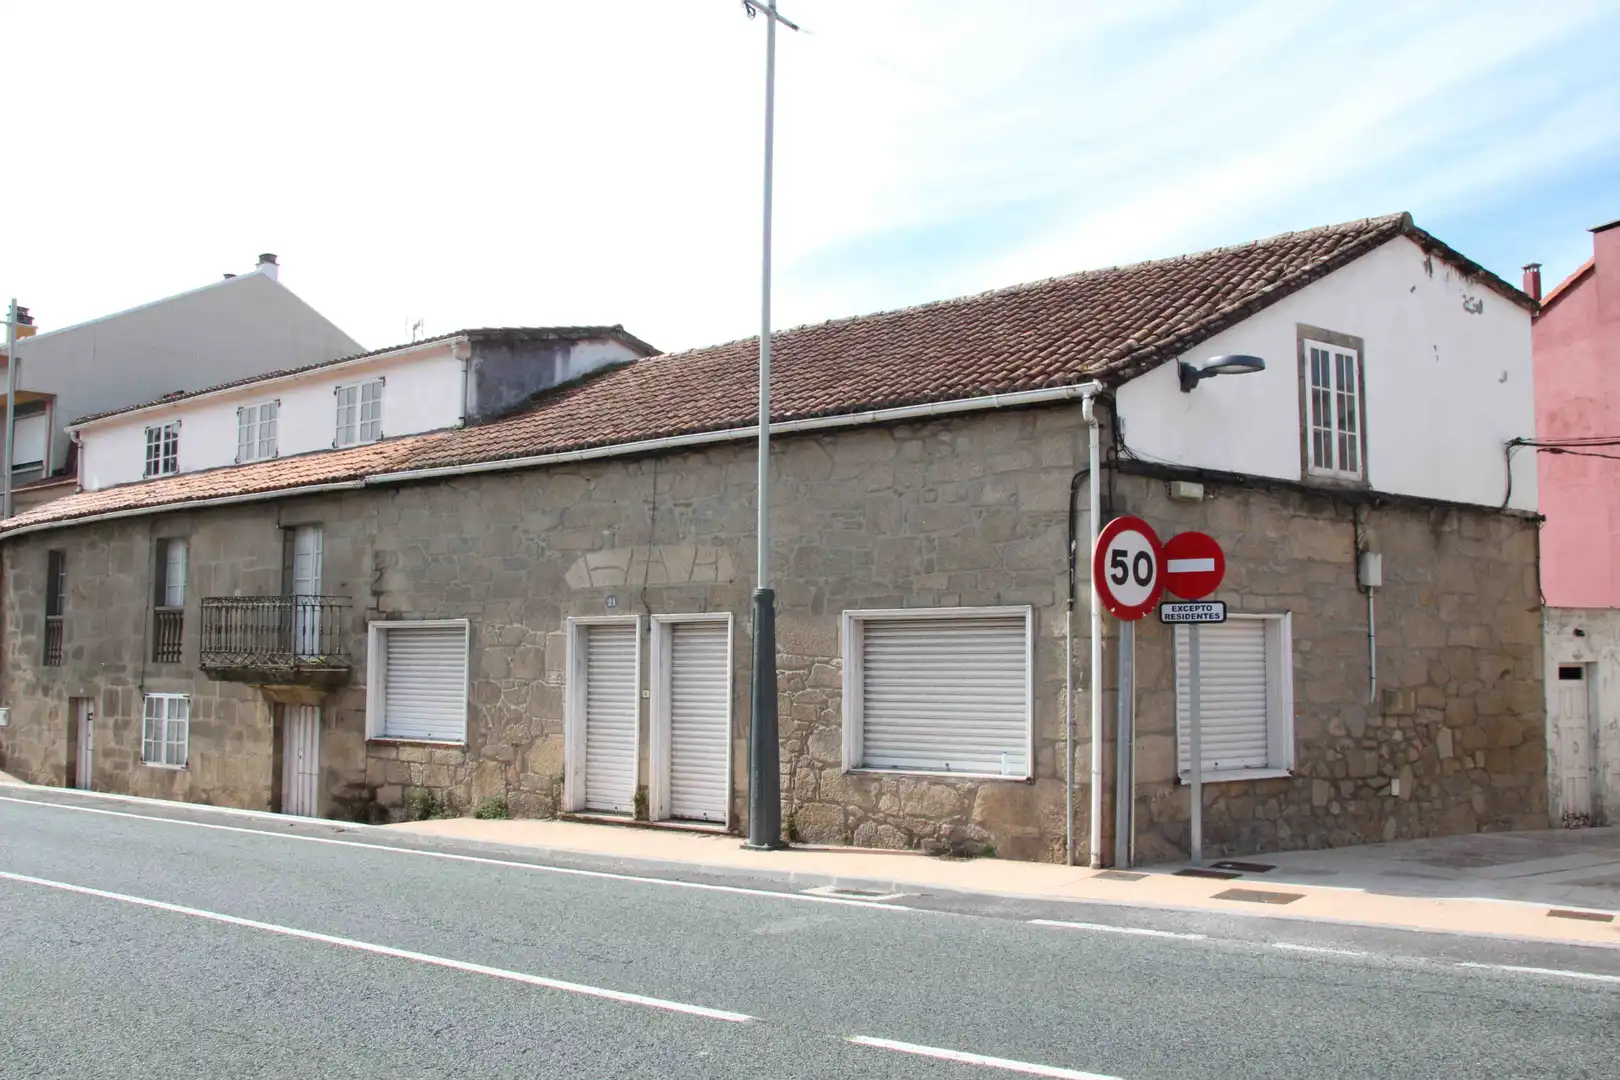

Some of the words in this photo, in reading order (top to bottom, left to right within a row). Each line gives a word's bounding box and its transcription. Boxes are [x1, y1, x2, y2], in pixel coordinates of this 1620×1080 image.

[1110, 549, 1153, 587] 50
[1171, 604, 1213, 612] EXCEPTO
[1164, 612, 1221, 620] RESIDENTES
